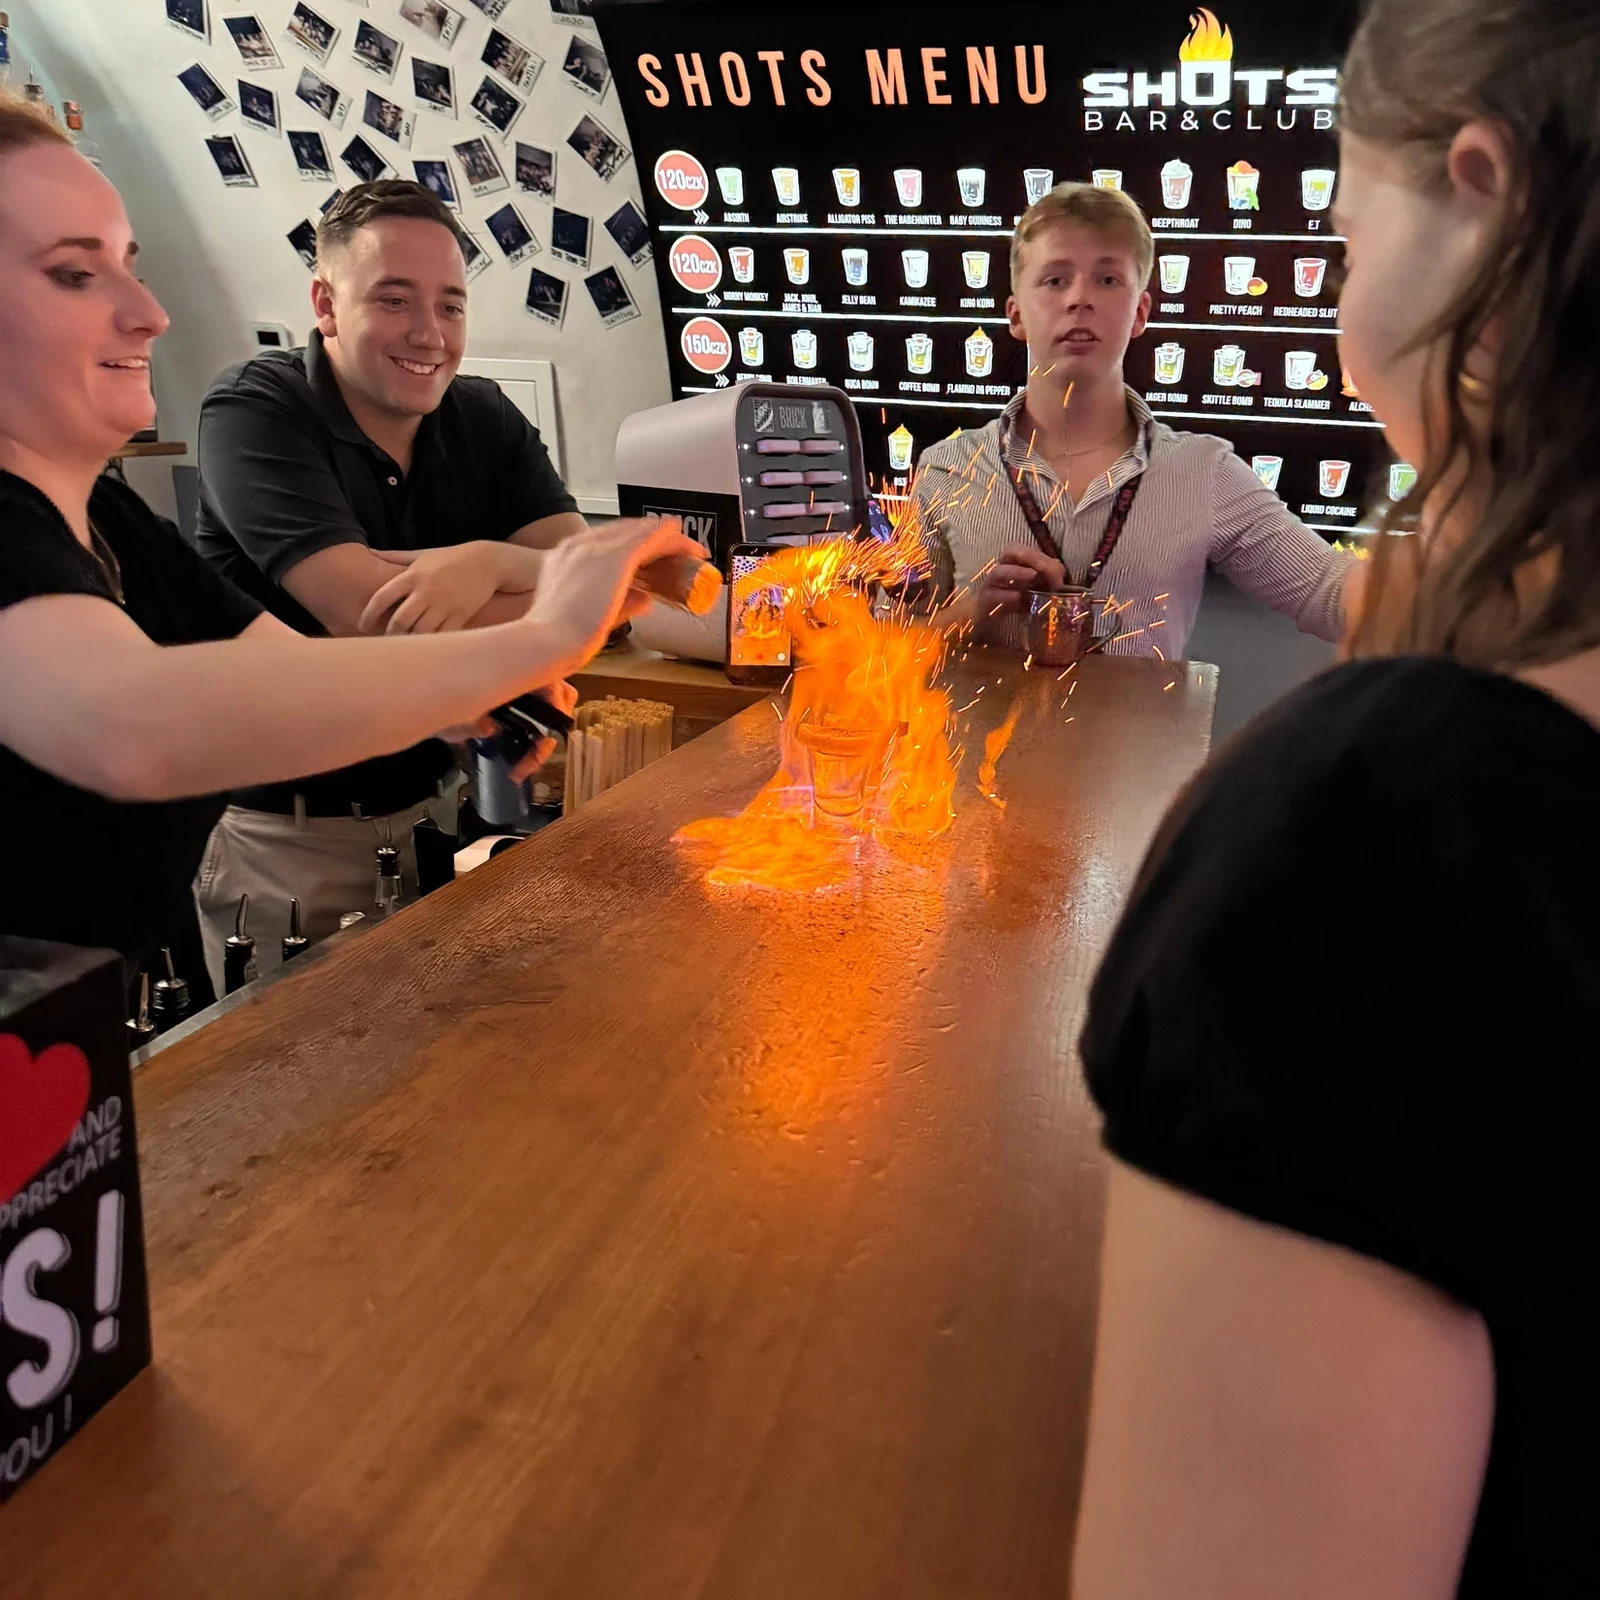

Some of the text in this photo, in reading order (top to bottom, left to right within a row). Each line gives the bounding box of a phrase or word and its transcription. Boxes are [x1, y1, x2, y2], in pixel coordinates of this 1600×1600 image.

[638, 45, 1046, 106] SHOTS MENU
[1082, 60, 1338, 107] SHOTS
[1085, 109, 1334, 131] BAR&CLUB
[724, 212, 749, 222] ABSINTH
[777, 213, 808, 223] AIRSTRIKE
[828, 214, 875, 224] ALLIGATOR PISS
[884, 215, 898, 224] THE
[950, 215, 967, 225] BABY
[968, 215, 1002, 226] GUINNESS
[1152, 218, 1199, 228] DEEPTHROAT
[1233, 219, 1251, 228] DINO
[673, 253, 718, 274] 120CZK
[723, 292, 743, 301] HORNY
[842, 295, 876, 305] JELLY BEAN
[960, 298, 994, 308] KING KONG
[1210, 305, 1262, 315] PRETTY PEACH
[1274, 307, 1338, 318] REDHEADED SLUT
[685, 334, 727, 355] 150CZK
[861, 380, 879, 389] BOMB
[899, 382, 940, 392] COFFEE BOMB
[948, 384, 975, 394] FLAMING
[985, 385, 1010, 395] PEPPER
[1168, 393, 1188, 403] BOMB
[1202, 395, 1253, 406] SKITTLE BOMB
[1264, 397, 1330, 409] TEQUILA SLAMMER
[779, 406, 808, 428] BRICK
[1301, 504, 1357, 516] LIQUID COCAINE
[67, 1095, 122, 1153] AND
